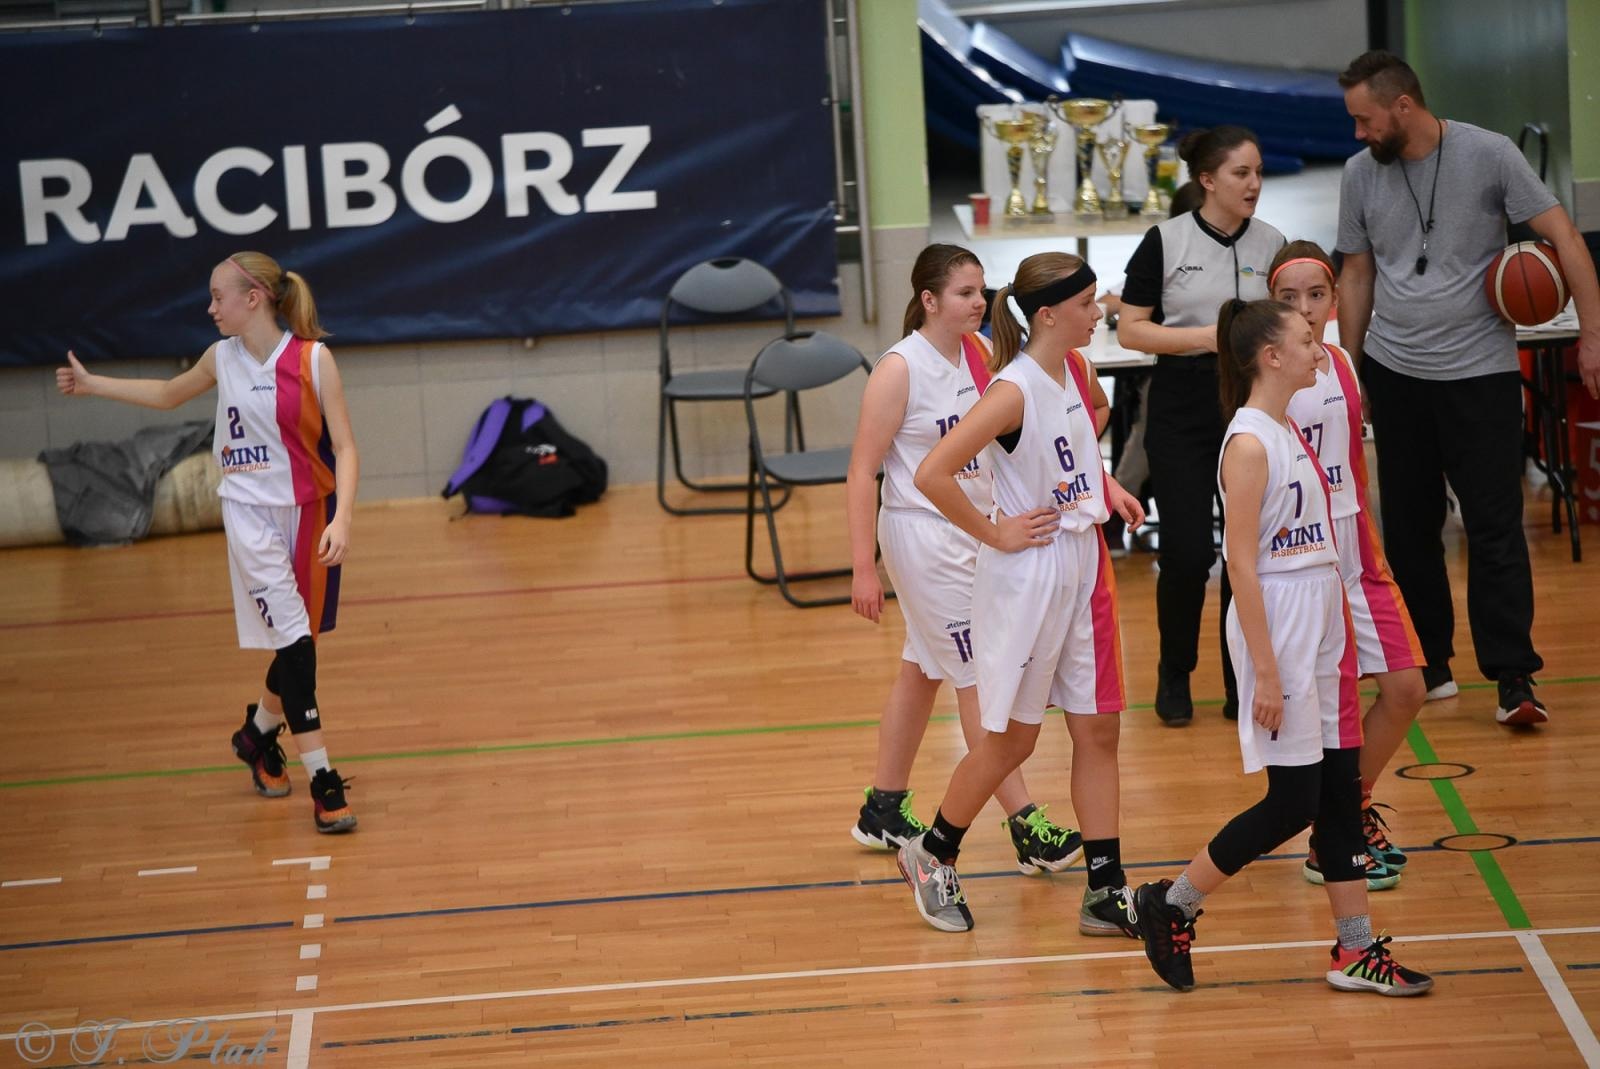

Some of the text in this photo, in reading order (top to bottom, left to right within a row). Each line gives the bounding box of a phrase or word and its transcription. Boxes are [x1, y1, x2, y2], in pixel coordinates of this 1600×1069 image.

[19, 104, 657, 246] RACIBÓRZ
[228, 406, 245, 440] 2
[221, 445, 270, 468] MINI
[1054, 435, 1075, 473] 6
[1324, 465, 1342, 485] NI
[1288, 480, 1303, 519] 7
[1271, 522, 1325, 551] MINI
[256, 597, 273, 628] 2
